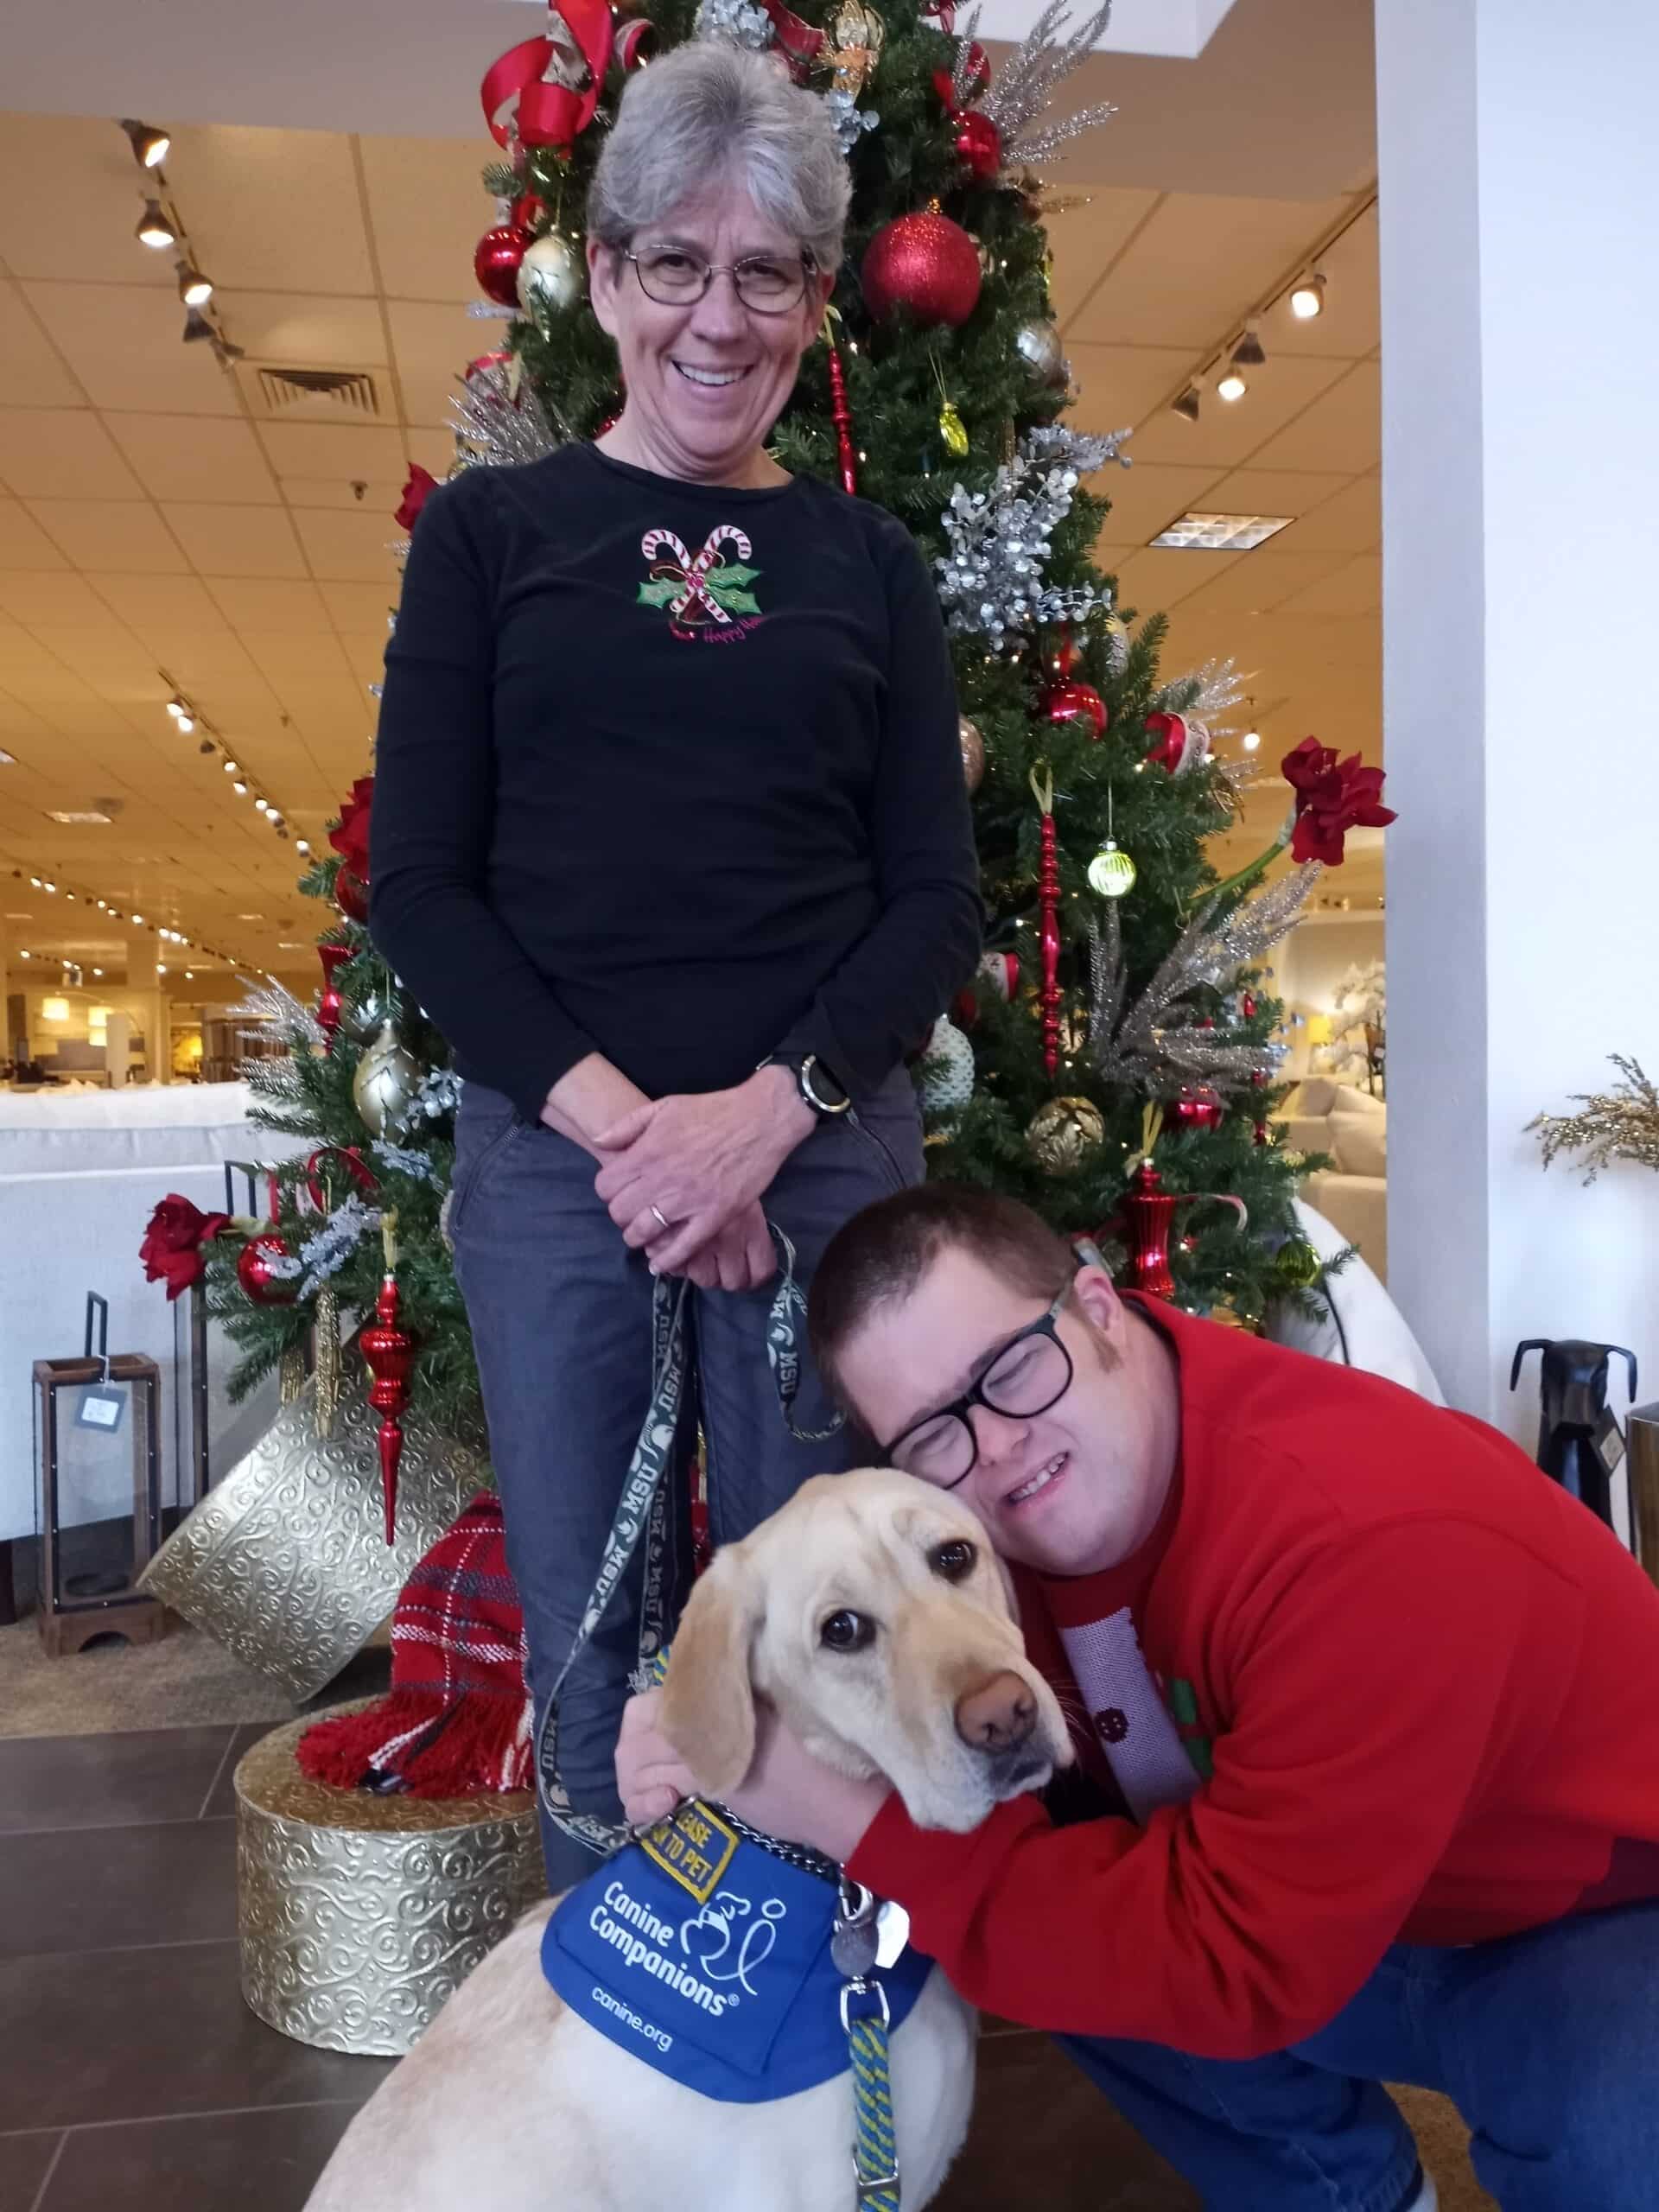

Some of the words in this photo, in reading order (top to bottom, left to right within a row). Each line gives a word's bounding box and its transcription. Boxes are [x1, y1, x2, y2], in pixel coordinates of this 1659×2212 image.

[658, 1363, 682, 1412] MSU
[779, 1351, 798, 1395] MSU
[622, 1462, 658, 1515] MSU
[595, 1546, 630, 1596] MSU
[542, 1718, 559, 1770] MSU
[675, 1811, 713, 1849] LEASE
[664, 1832, 685, 1860] TO
[679, 1847, 713, 1883] PET
[604, 1881, 674, 1947] Canine
[591, 1986, 674, 2053] canine.org
